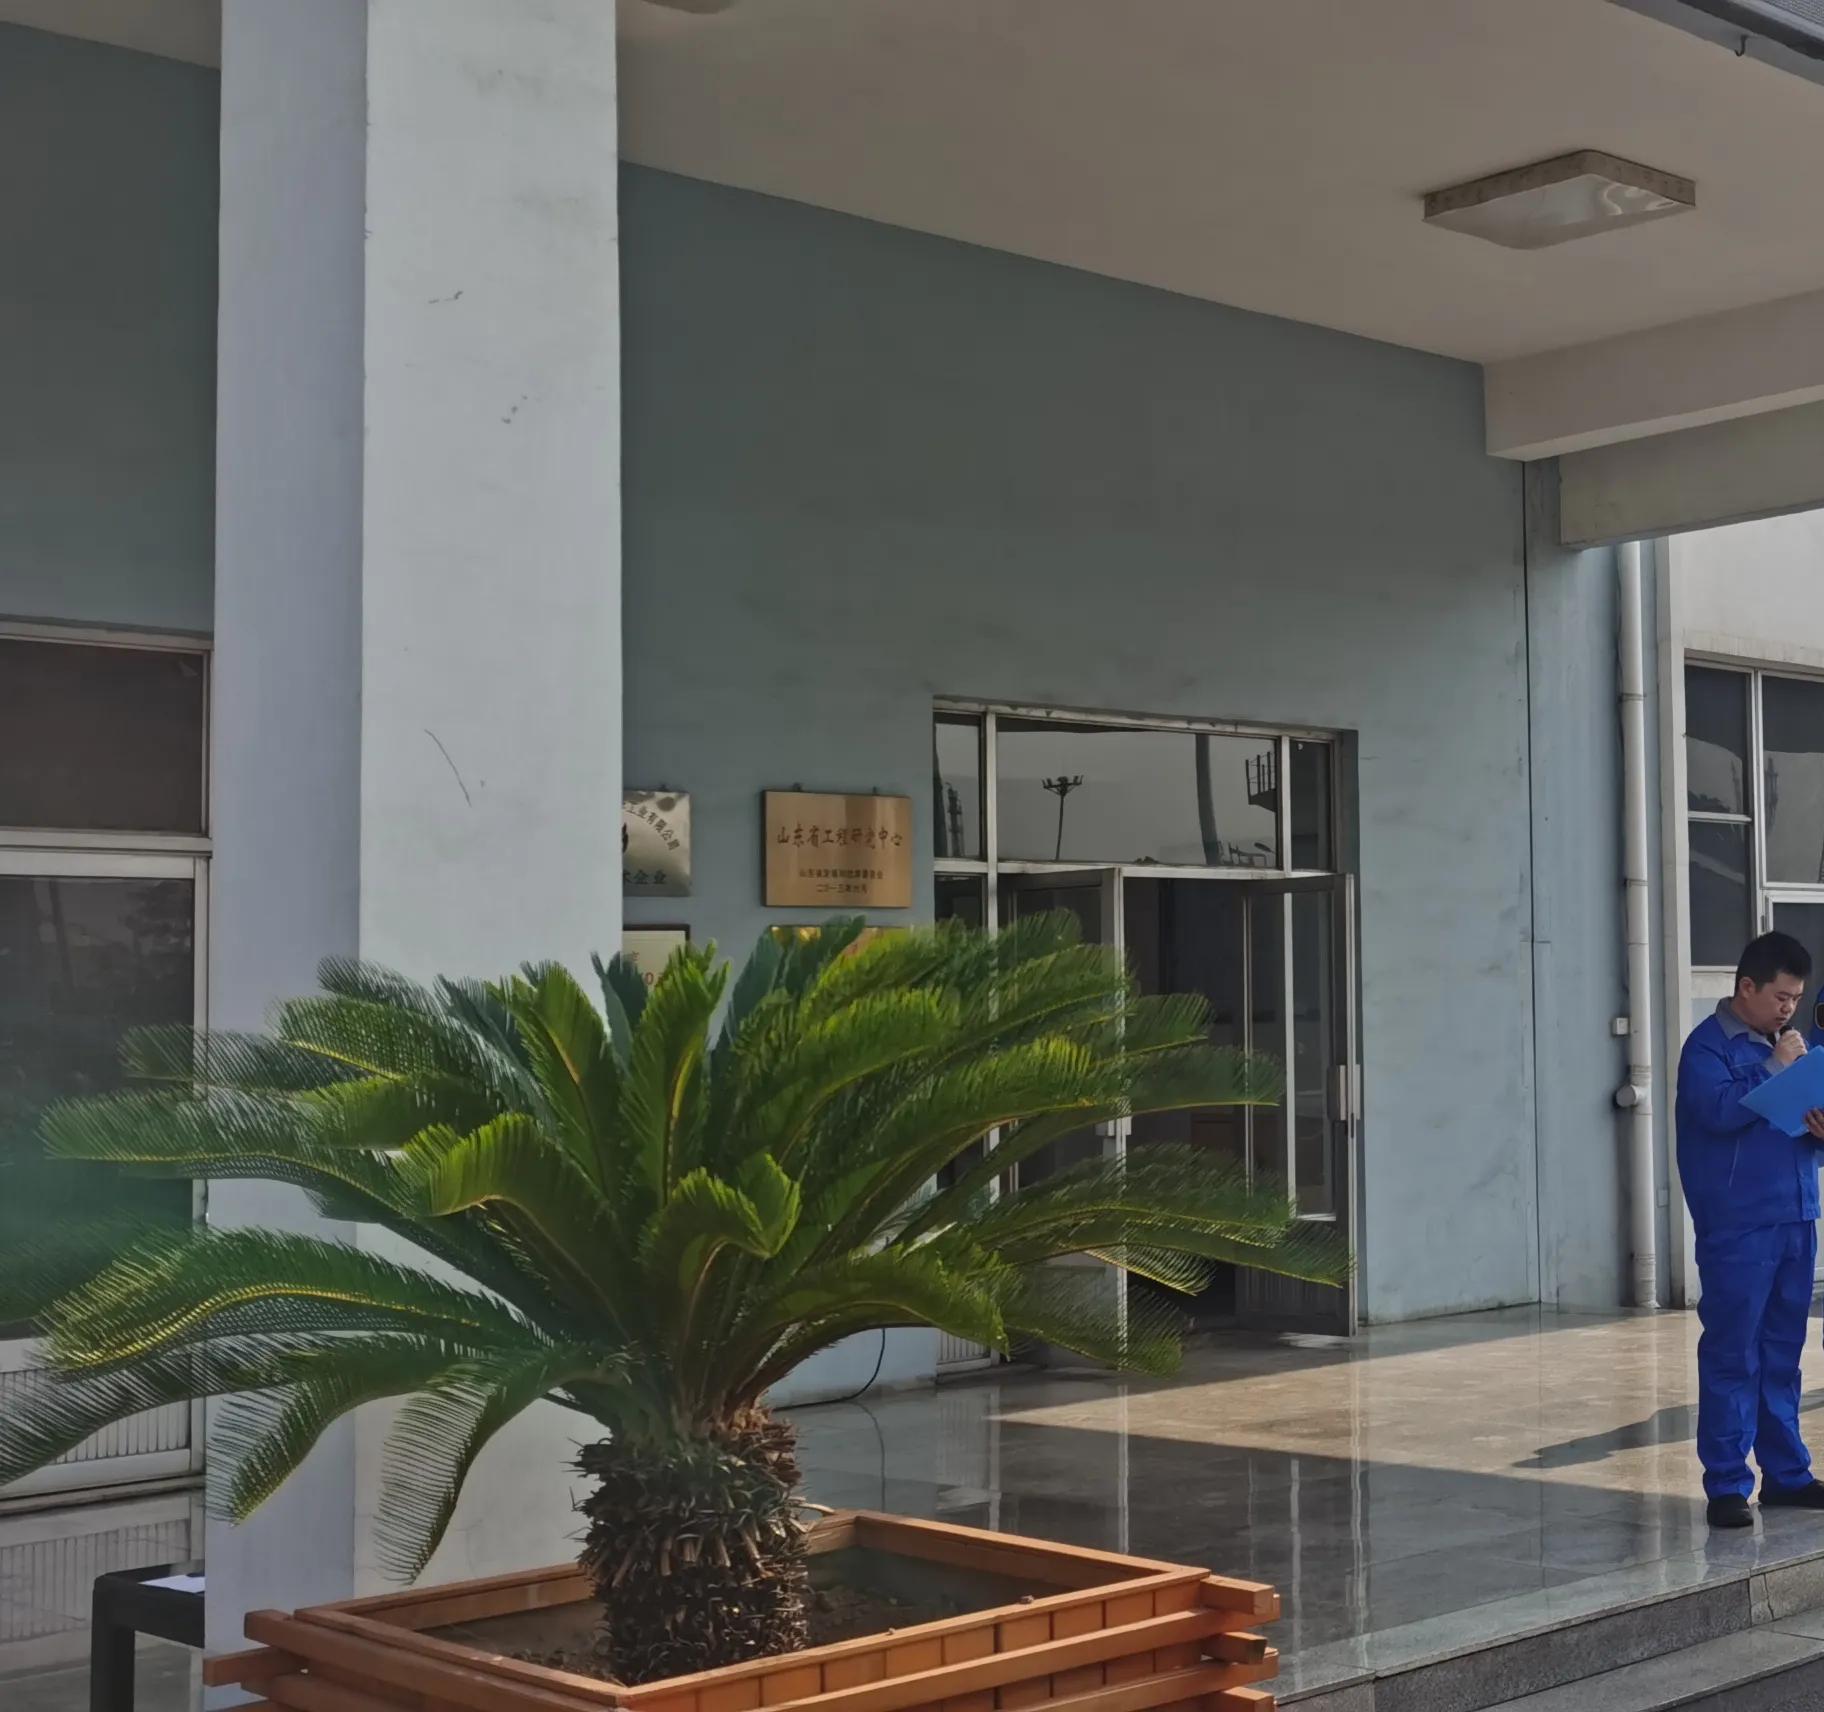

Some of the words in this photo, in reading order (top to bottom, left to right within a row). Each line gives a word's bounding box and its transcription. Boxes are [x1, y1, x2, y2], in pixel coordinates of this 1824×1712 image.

[776, 822, 903, 849] 山东省工程研究中心
